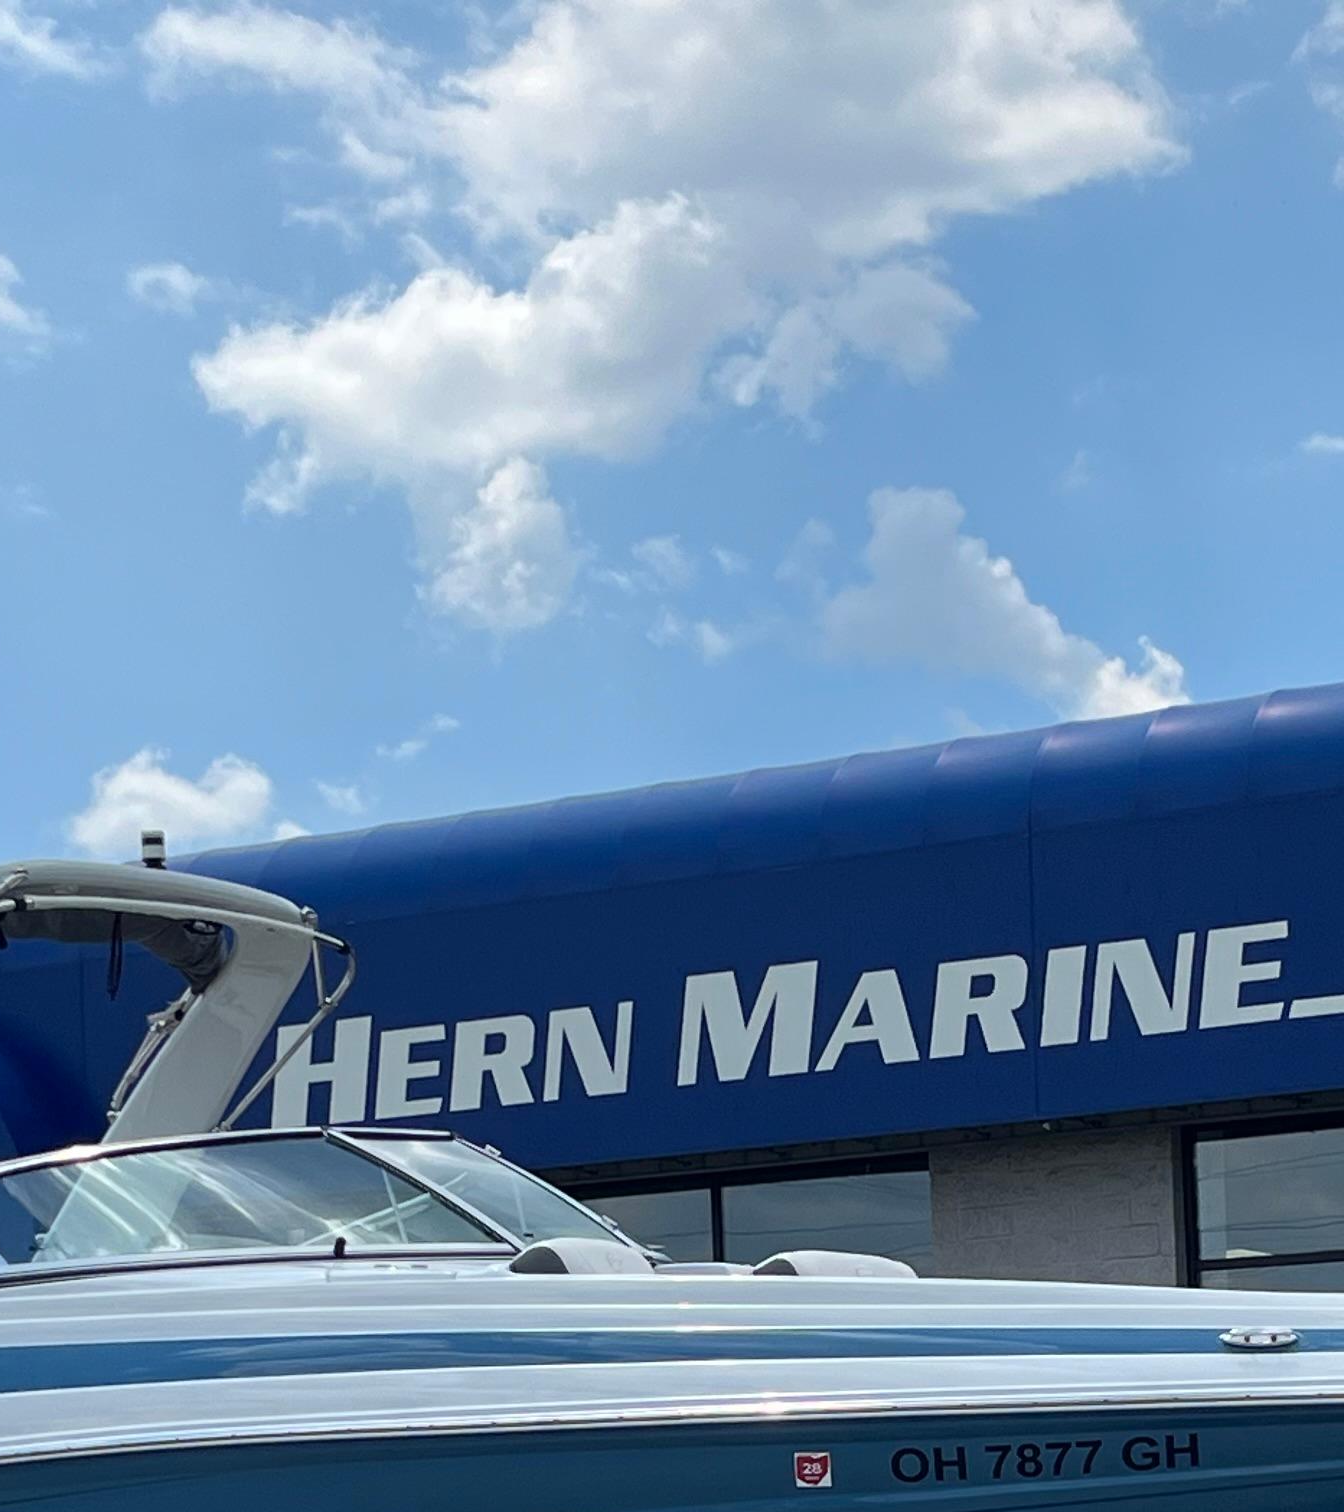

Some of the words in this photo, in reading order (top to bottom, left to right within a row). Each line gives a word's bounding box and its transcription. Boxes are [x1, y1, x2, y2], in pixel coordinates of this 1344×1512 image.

[271, 1000, 634, 1129] HERN
[676, 919, 1289, 1087] MARINE
[890, 1447, 968, 1482] OH
[984, 1439, 1103, 1479] 7877
[1121, 1433, 1200, 1472] GH
